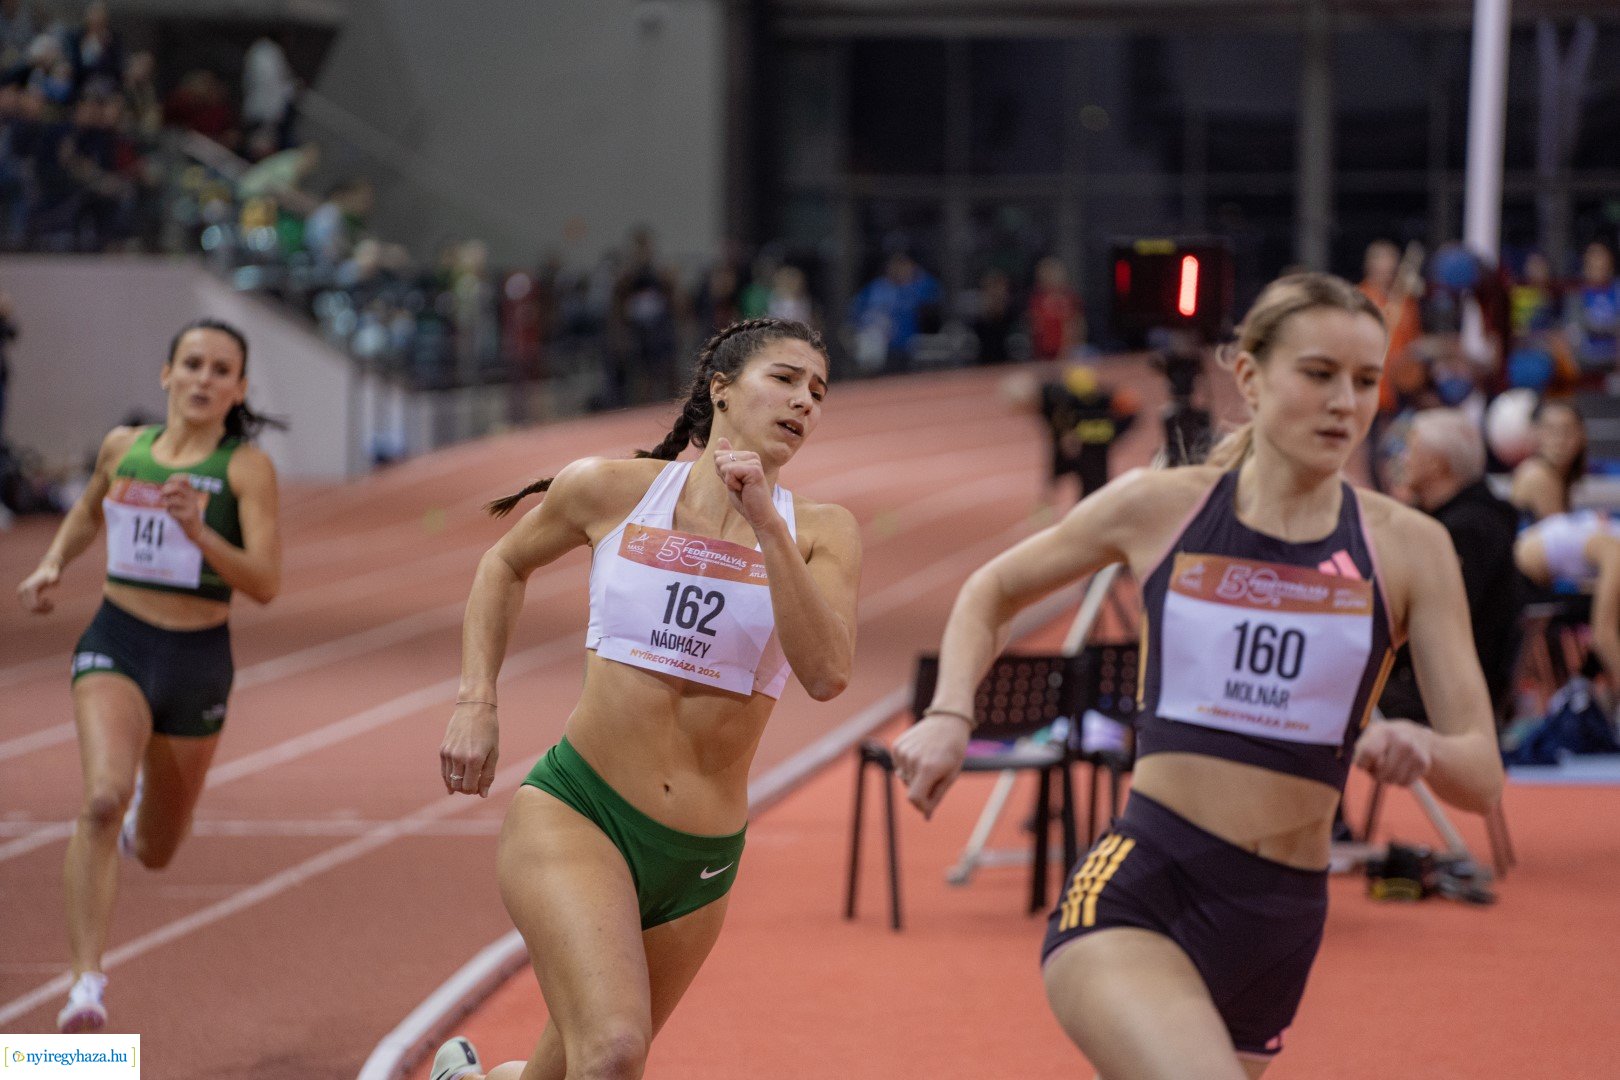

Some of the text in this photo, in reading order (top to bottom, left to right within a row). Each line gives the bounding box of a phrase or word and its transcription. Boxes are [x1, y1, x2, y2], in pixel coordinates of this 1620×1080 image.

[132, 515, 165, 549] 141
[682, 546, 748, 568] FEDETTPÁLYÁS
[662, 581, 726, 637] 162
[650, 629, 712, 659] NÁDHÁZY
[1233, 619, 1306, 681] 160
[630, 648, 721, 679] NYÍREGYHÁZA 2024
[1223, 677, 1291, 710] MOLNÁR
